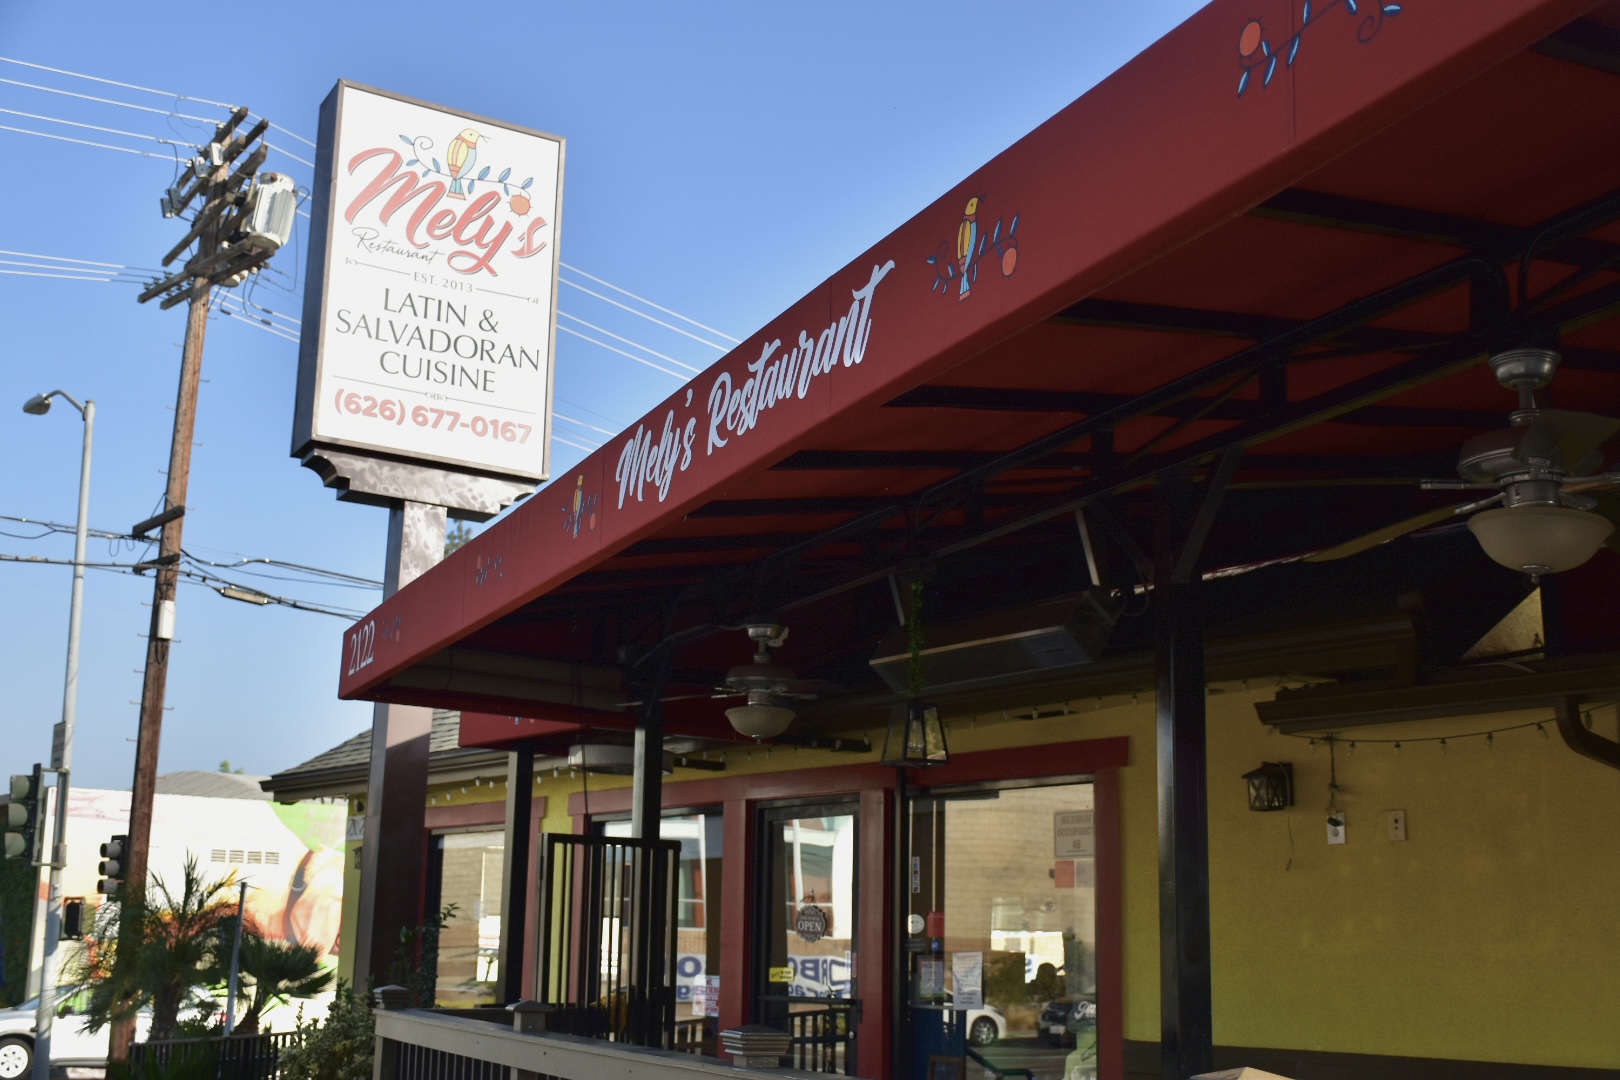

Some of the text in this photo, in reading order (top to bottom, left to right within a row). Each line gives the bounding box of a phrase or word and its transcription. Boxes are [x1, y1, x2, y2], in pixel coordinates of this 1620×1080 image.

[345, 146, 547, 278] Mely's
[352, 226, 445, 265] Restaurant
[414, 271, 473, 293] EST. 2013
[384, 287, 499, 333] LATIN &
[335, 308, 540, 371] SALVADORAN
[379, 350, 496, 393] CUISINE
[615, 259, 896, 510] Mely's Restaurant
[334, 388, 532, 444] (626) 677-0167
[348, 619, 375, 676] 2122
[797, 920, 822, 932] OPEN
